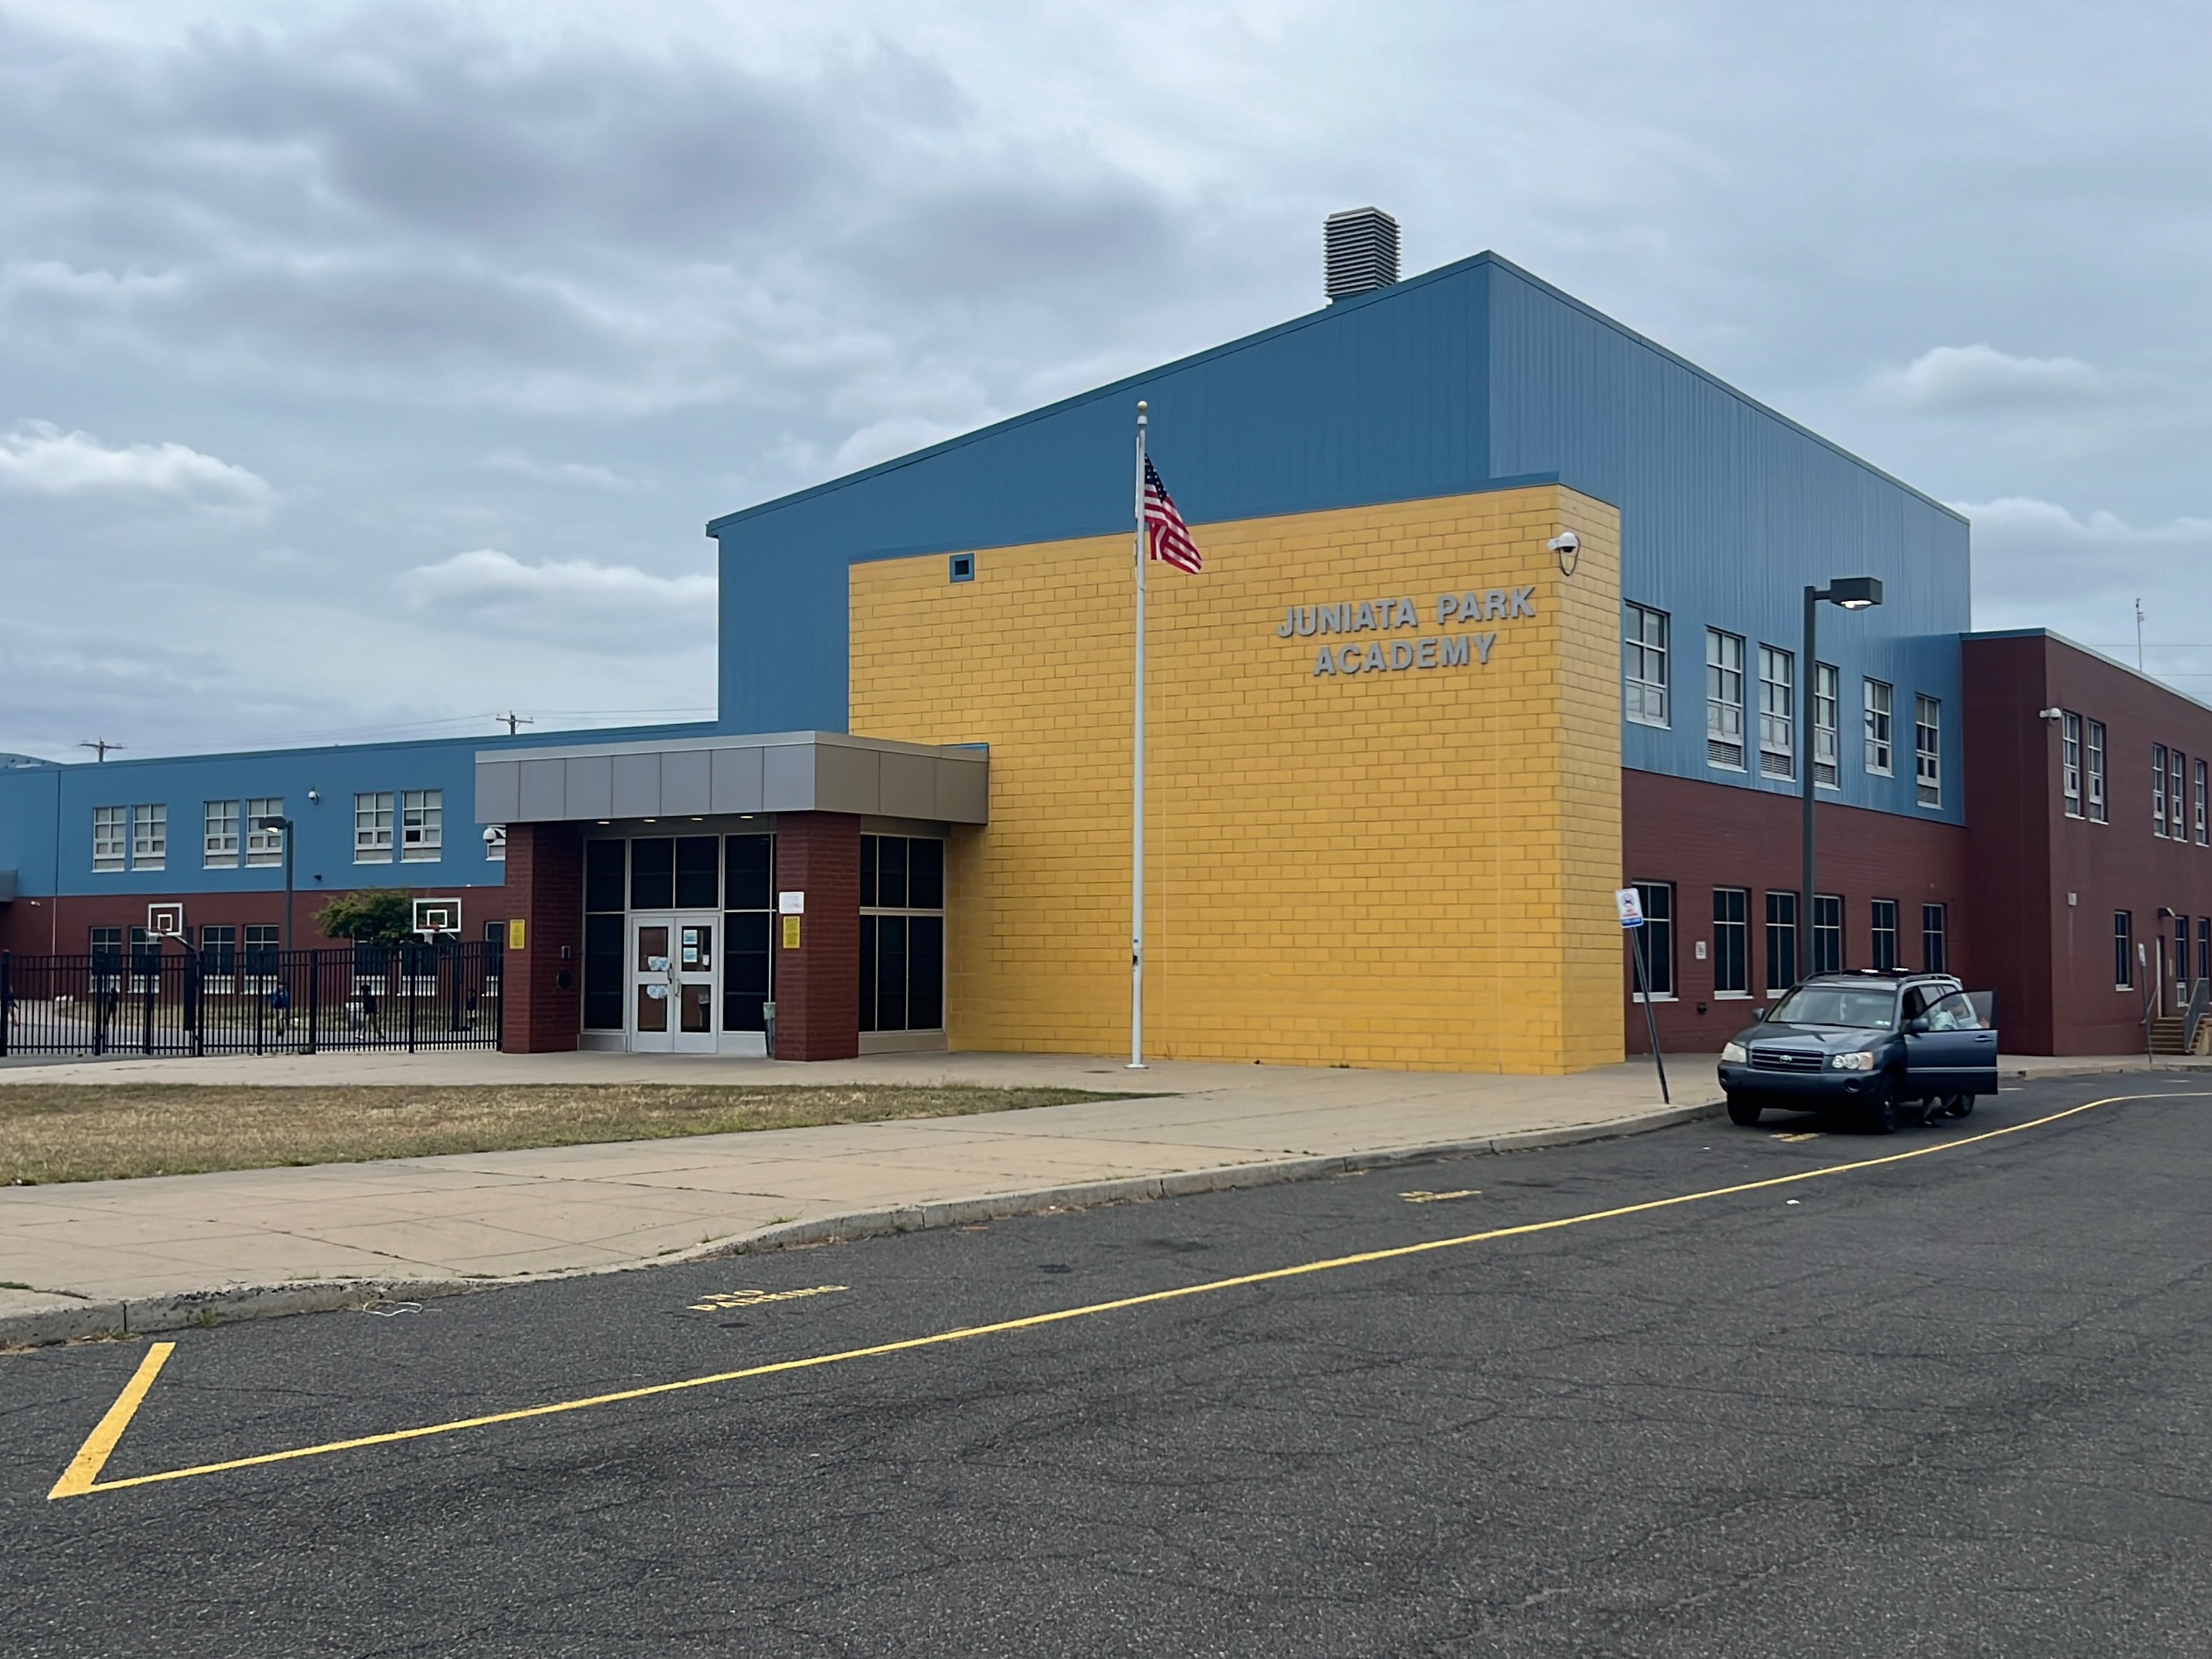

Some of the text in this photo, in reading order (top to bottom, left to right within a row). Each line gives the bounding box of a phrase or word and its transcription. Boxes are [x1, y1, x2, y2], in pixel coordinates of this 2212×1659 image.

[1277, 586, 1536, 637] JUNIATA PARK
[1313, 633, 1496, 676] ACADEMY
